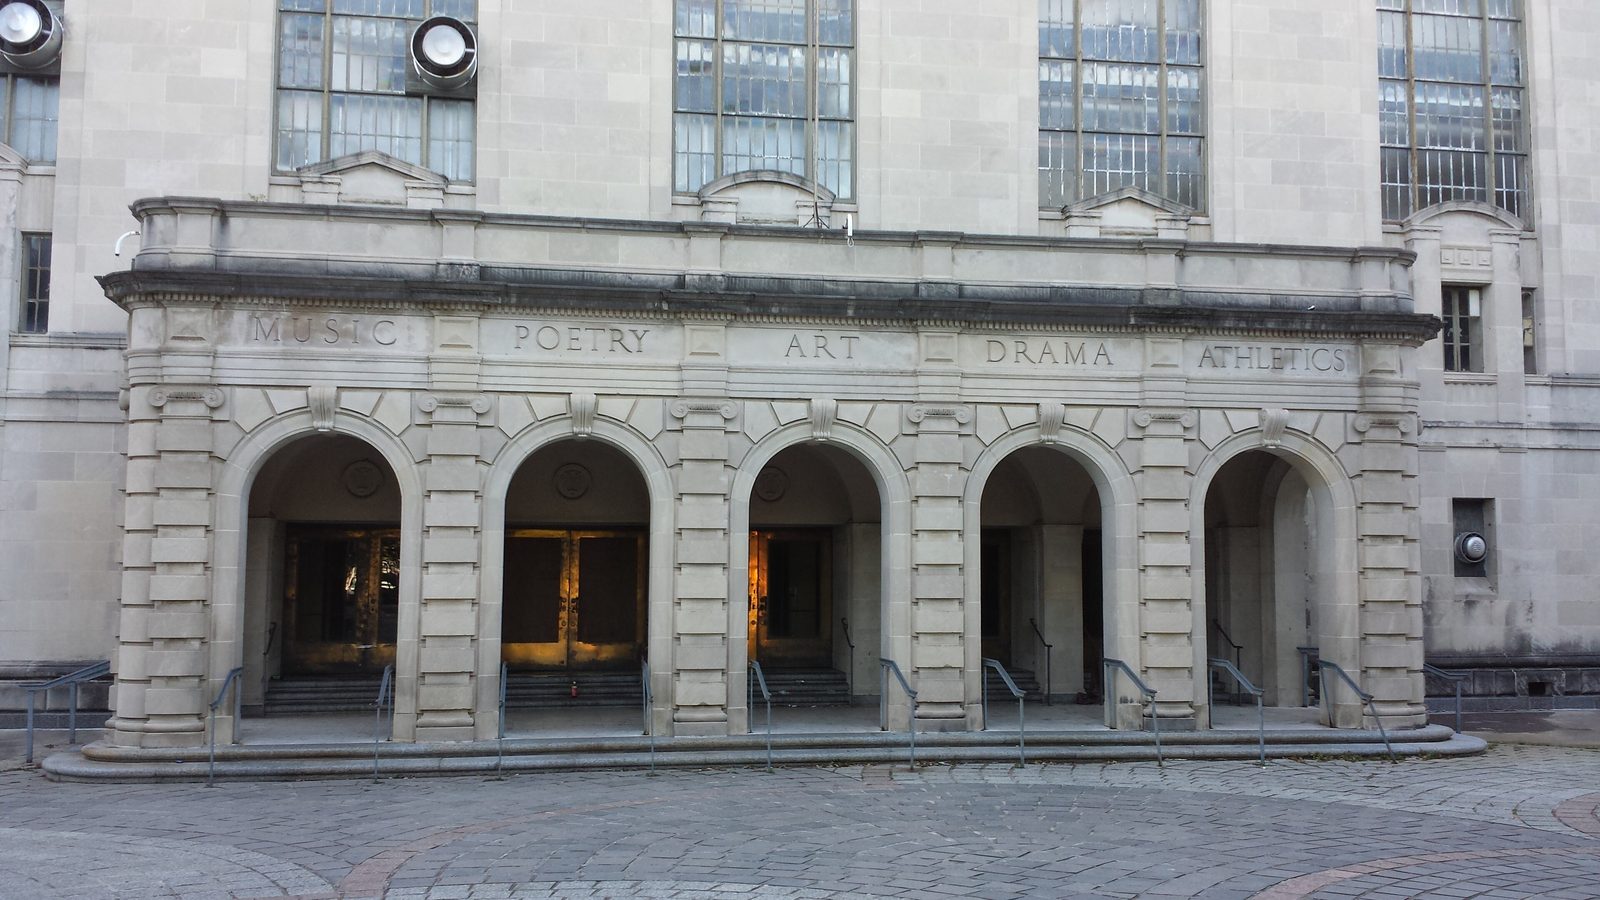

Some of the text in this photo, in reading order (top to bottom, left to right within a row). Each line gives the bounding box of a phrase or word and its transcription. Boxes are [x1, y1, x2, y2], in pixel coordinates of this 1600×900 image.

[252, 316, 398, 346] MUSIC
[514, 324, 651, 354] POETRY
[784, 334, 860, 360] ART
[986, 339, 1114, 366] DRAMA
[1197, 345, 1346, 372] ATHLETICS
